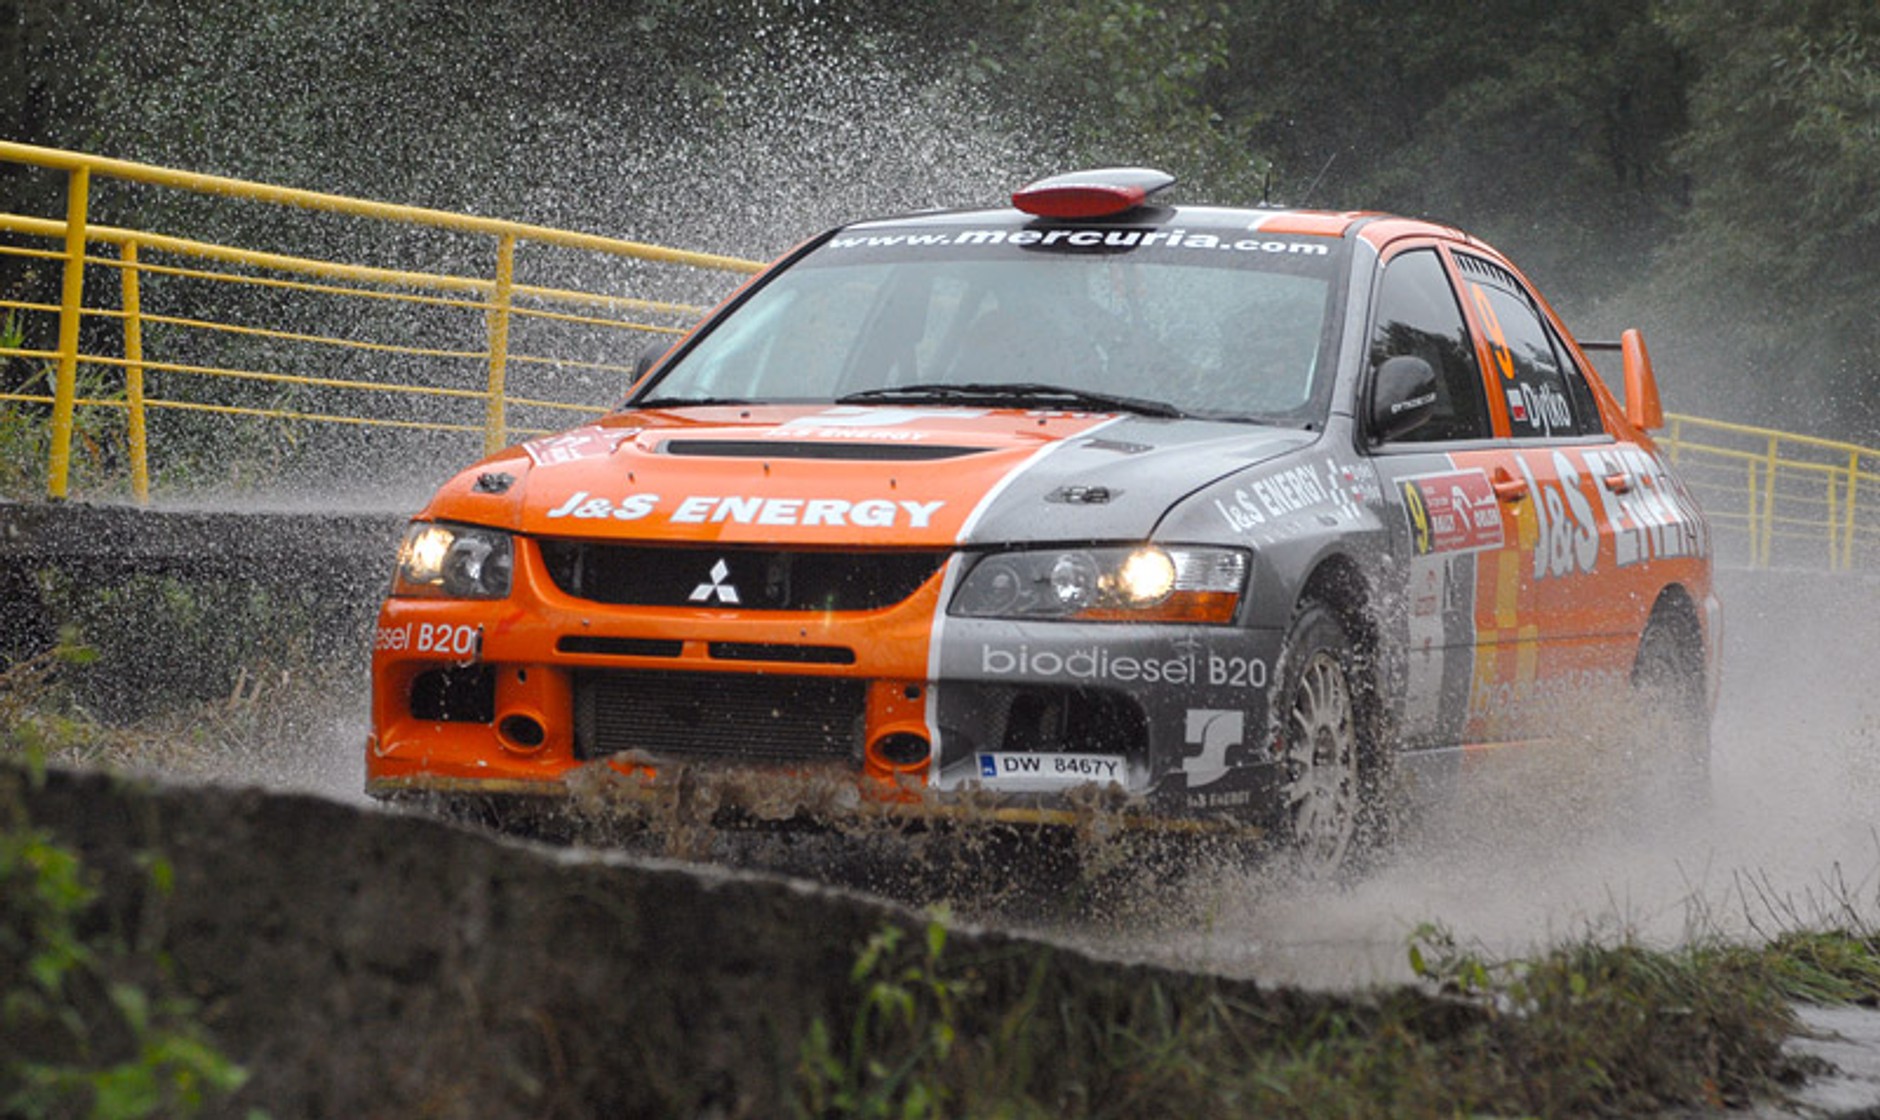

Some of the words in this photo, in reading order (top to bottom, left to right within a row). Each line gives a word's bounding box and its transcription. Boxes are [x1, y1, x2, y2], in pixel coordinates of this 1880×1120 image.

[829, 228, 1329, 256] www.mercuria.com
[1471, 282, 1516, 380] 9
[546, 490, 661, 521] J&S
[669, 495, 947, 529] ENERGY
[1213, 488, 1266, 533] J&S
[1252, 462, 1330, 518] ENERGY
[1404, 480, 1429, 554] 9
[1516, 451, 1600, 581] J&S
[417, 622, 473, 654] B20
[981, 644, 1197, 684] biodiesel
[1208, 656, 1267, 688] B20
[1003, 756, 1041, 772] DW
[1054, 757, 1118, 776] 8467Y
